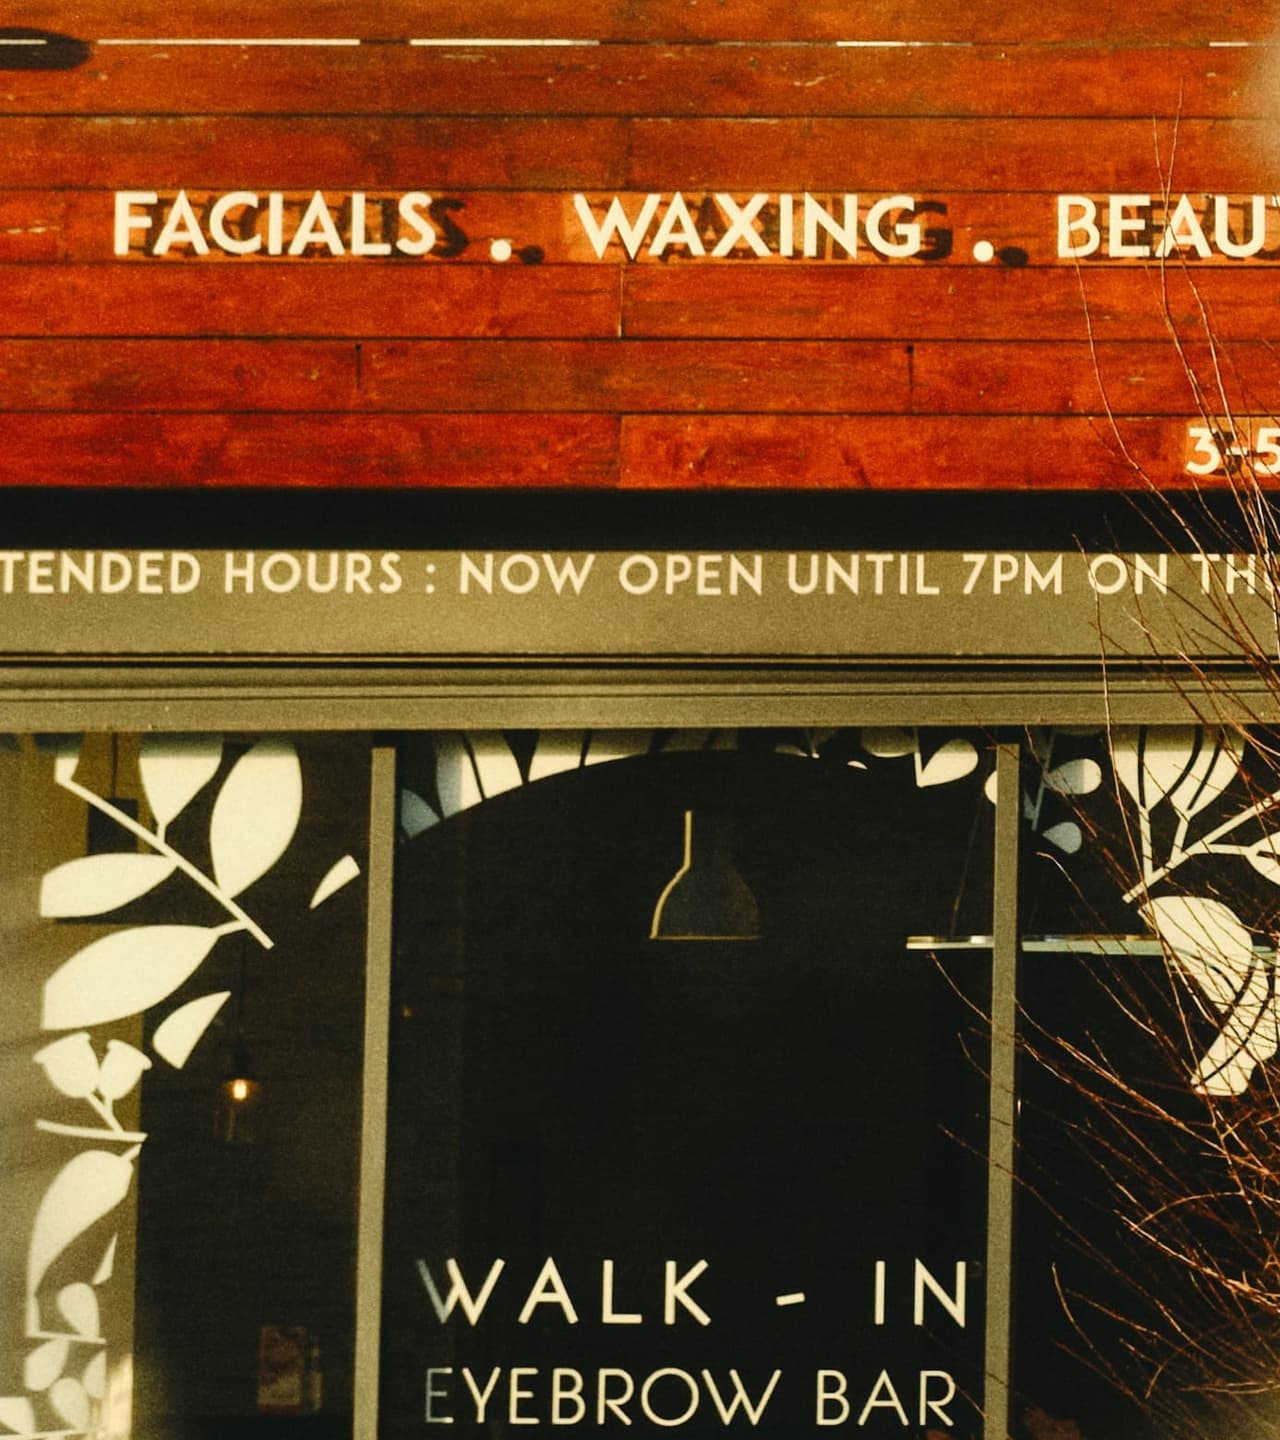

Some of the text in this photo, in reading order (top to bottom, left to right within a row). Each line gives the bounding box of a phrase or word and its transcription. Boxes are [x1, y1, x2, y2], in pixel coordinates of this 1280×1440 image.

[114, 189, 436, 258] FACIALS
[573, 191, 922, 260] WAXING
[0, 551, 202, 594] TENDED
[225, 552, 403, 594] HOURS
[459, 553, 596, 594] NOW
[618, 553, 763, 595] OPEN
[787, 554, 940, 595] UNTIL
[962, 554, 1062, 595] 7PM
[1088, 554, 1169, 595] ON
[417, 1256, 711, 1327] WALK
[874, 1258, 967, 1328] IN
[424, 1366, 957, 1427] EYEBROW BAR
